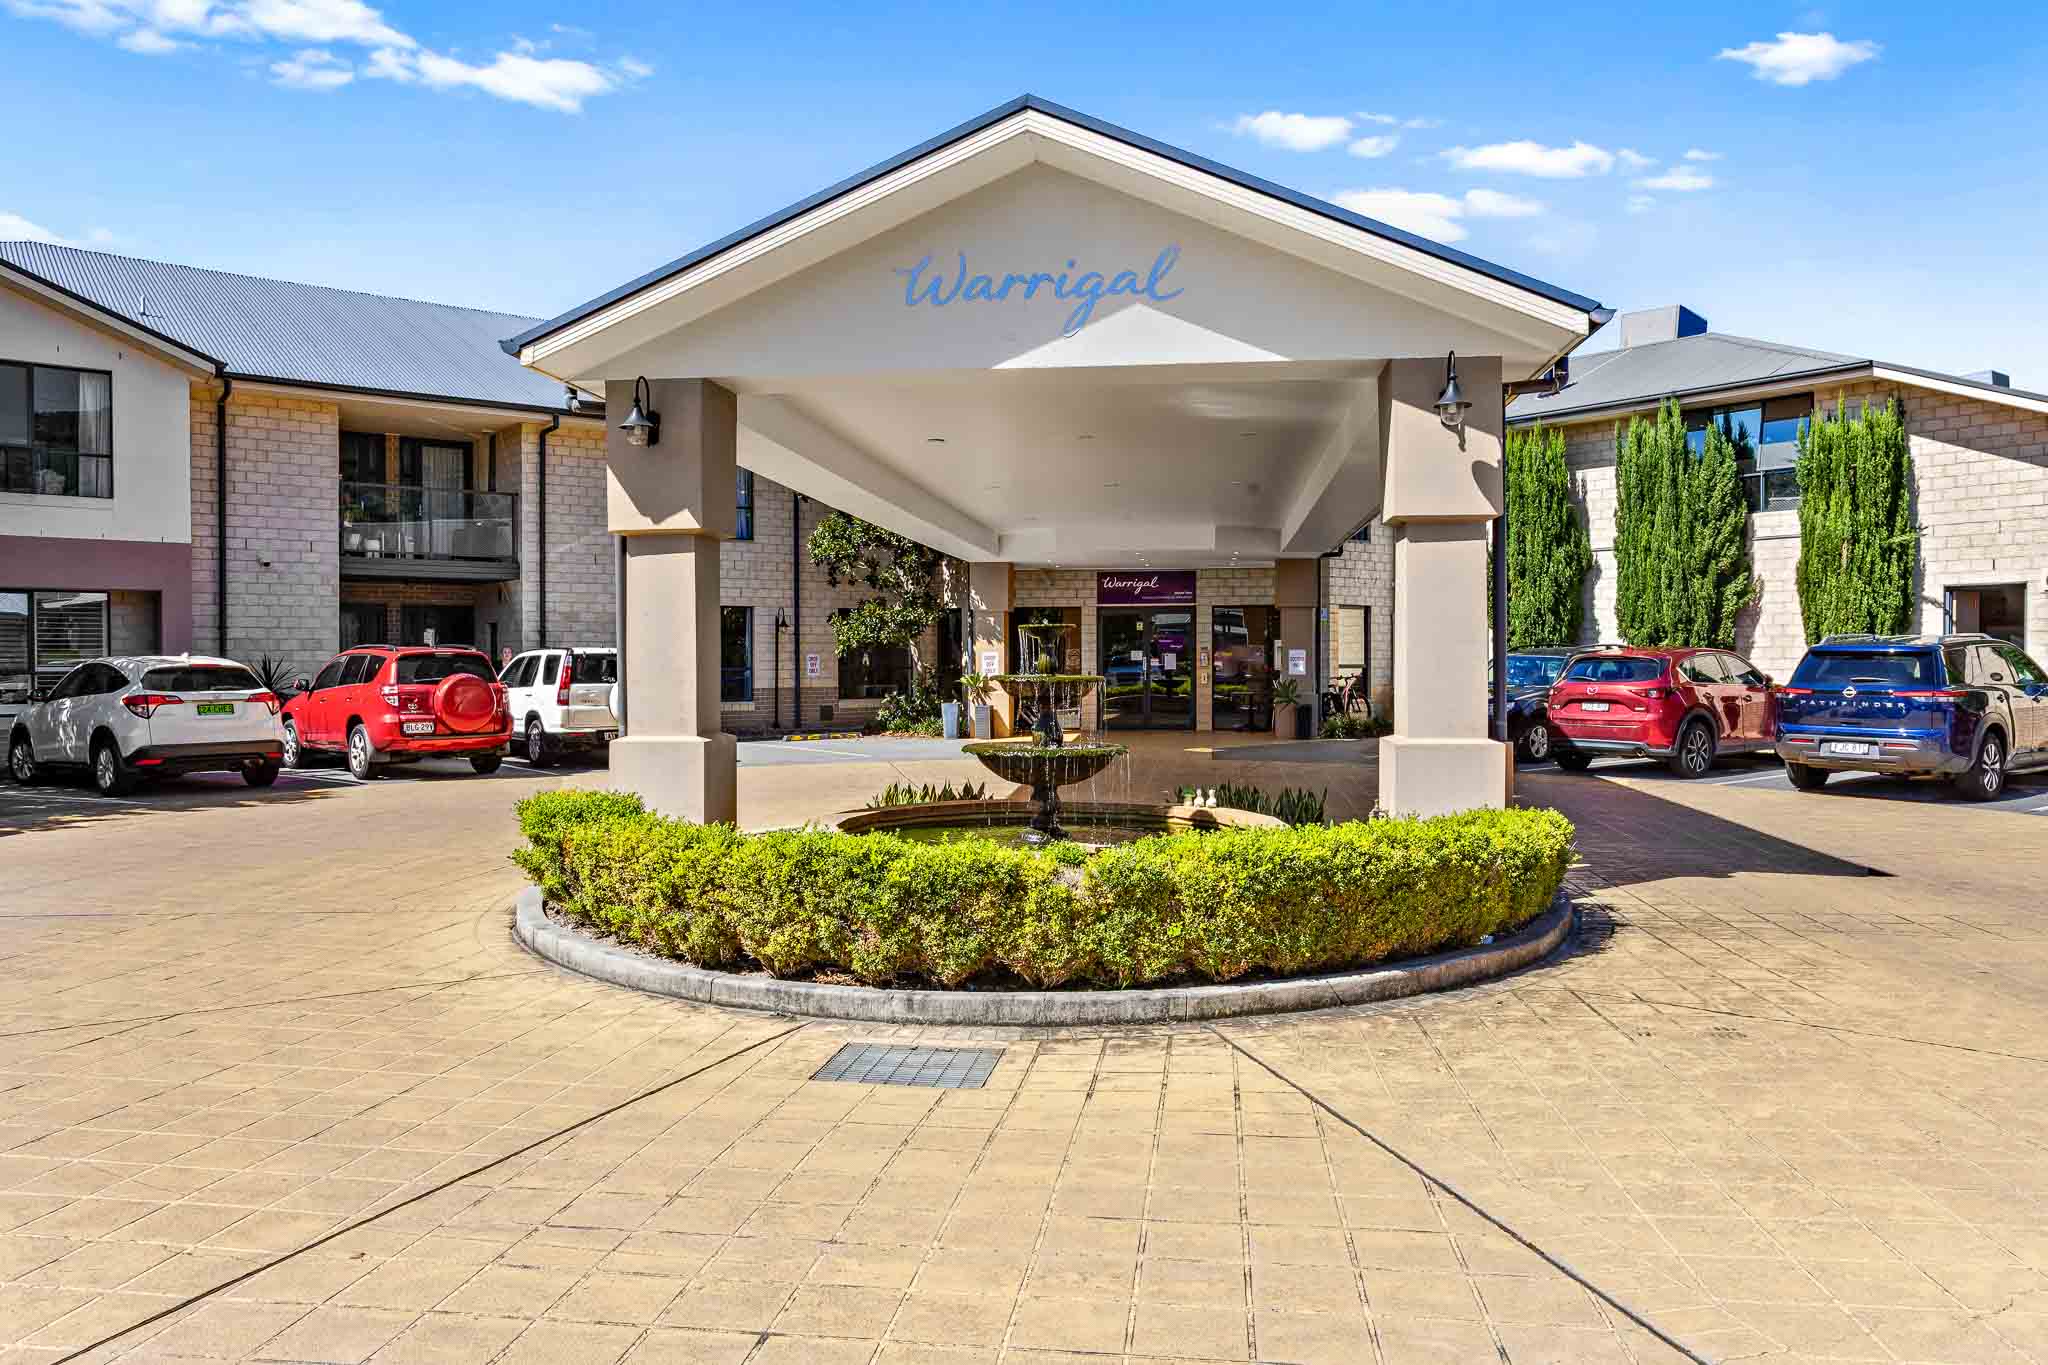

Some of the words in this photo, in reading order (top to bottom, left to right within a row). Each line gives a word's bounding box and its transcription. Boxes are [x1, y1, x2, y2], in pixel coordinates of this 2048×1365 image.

[893, 241, 1185, 338] Warrigal
[1102, 576, 1160, 595] Warrigal
[1799, 700, 1906, 709] PATHFINDER
